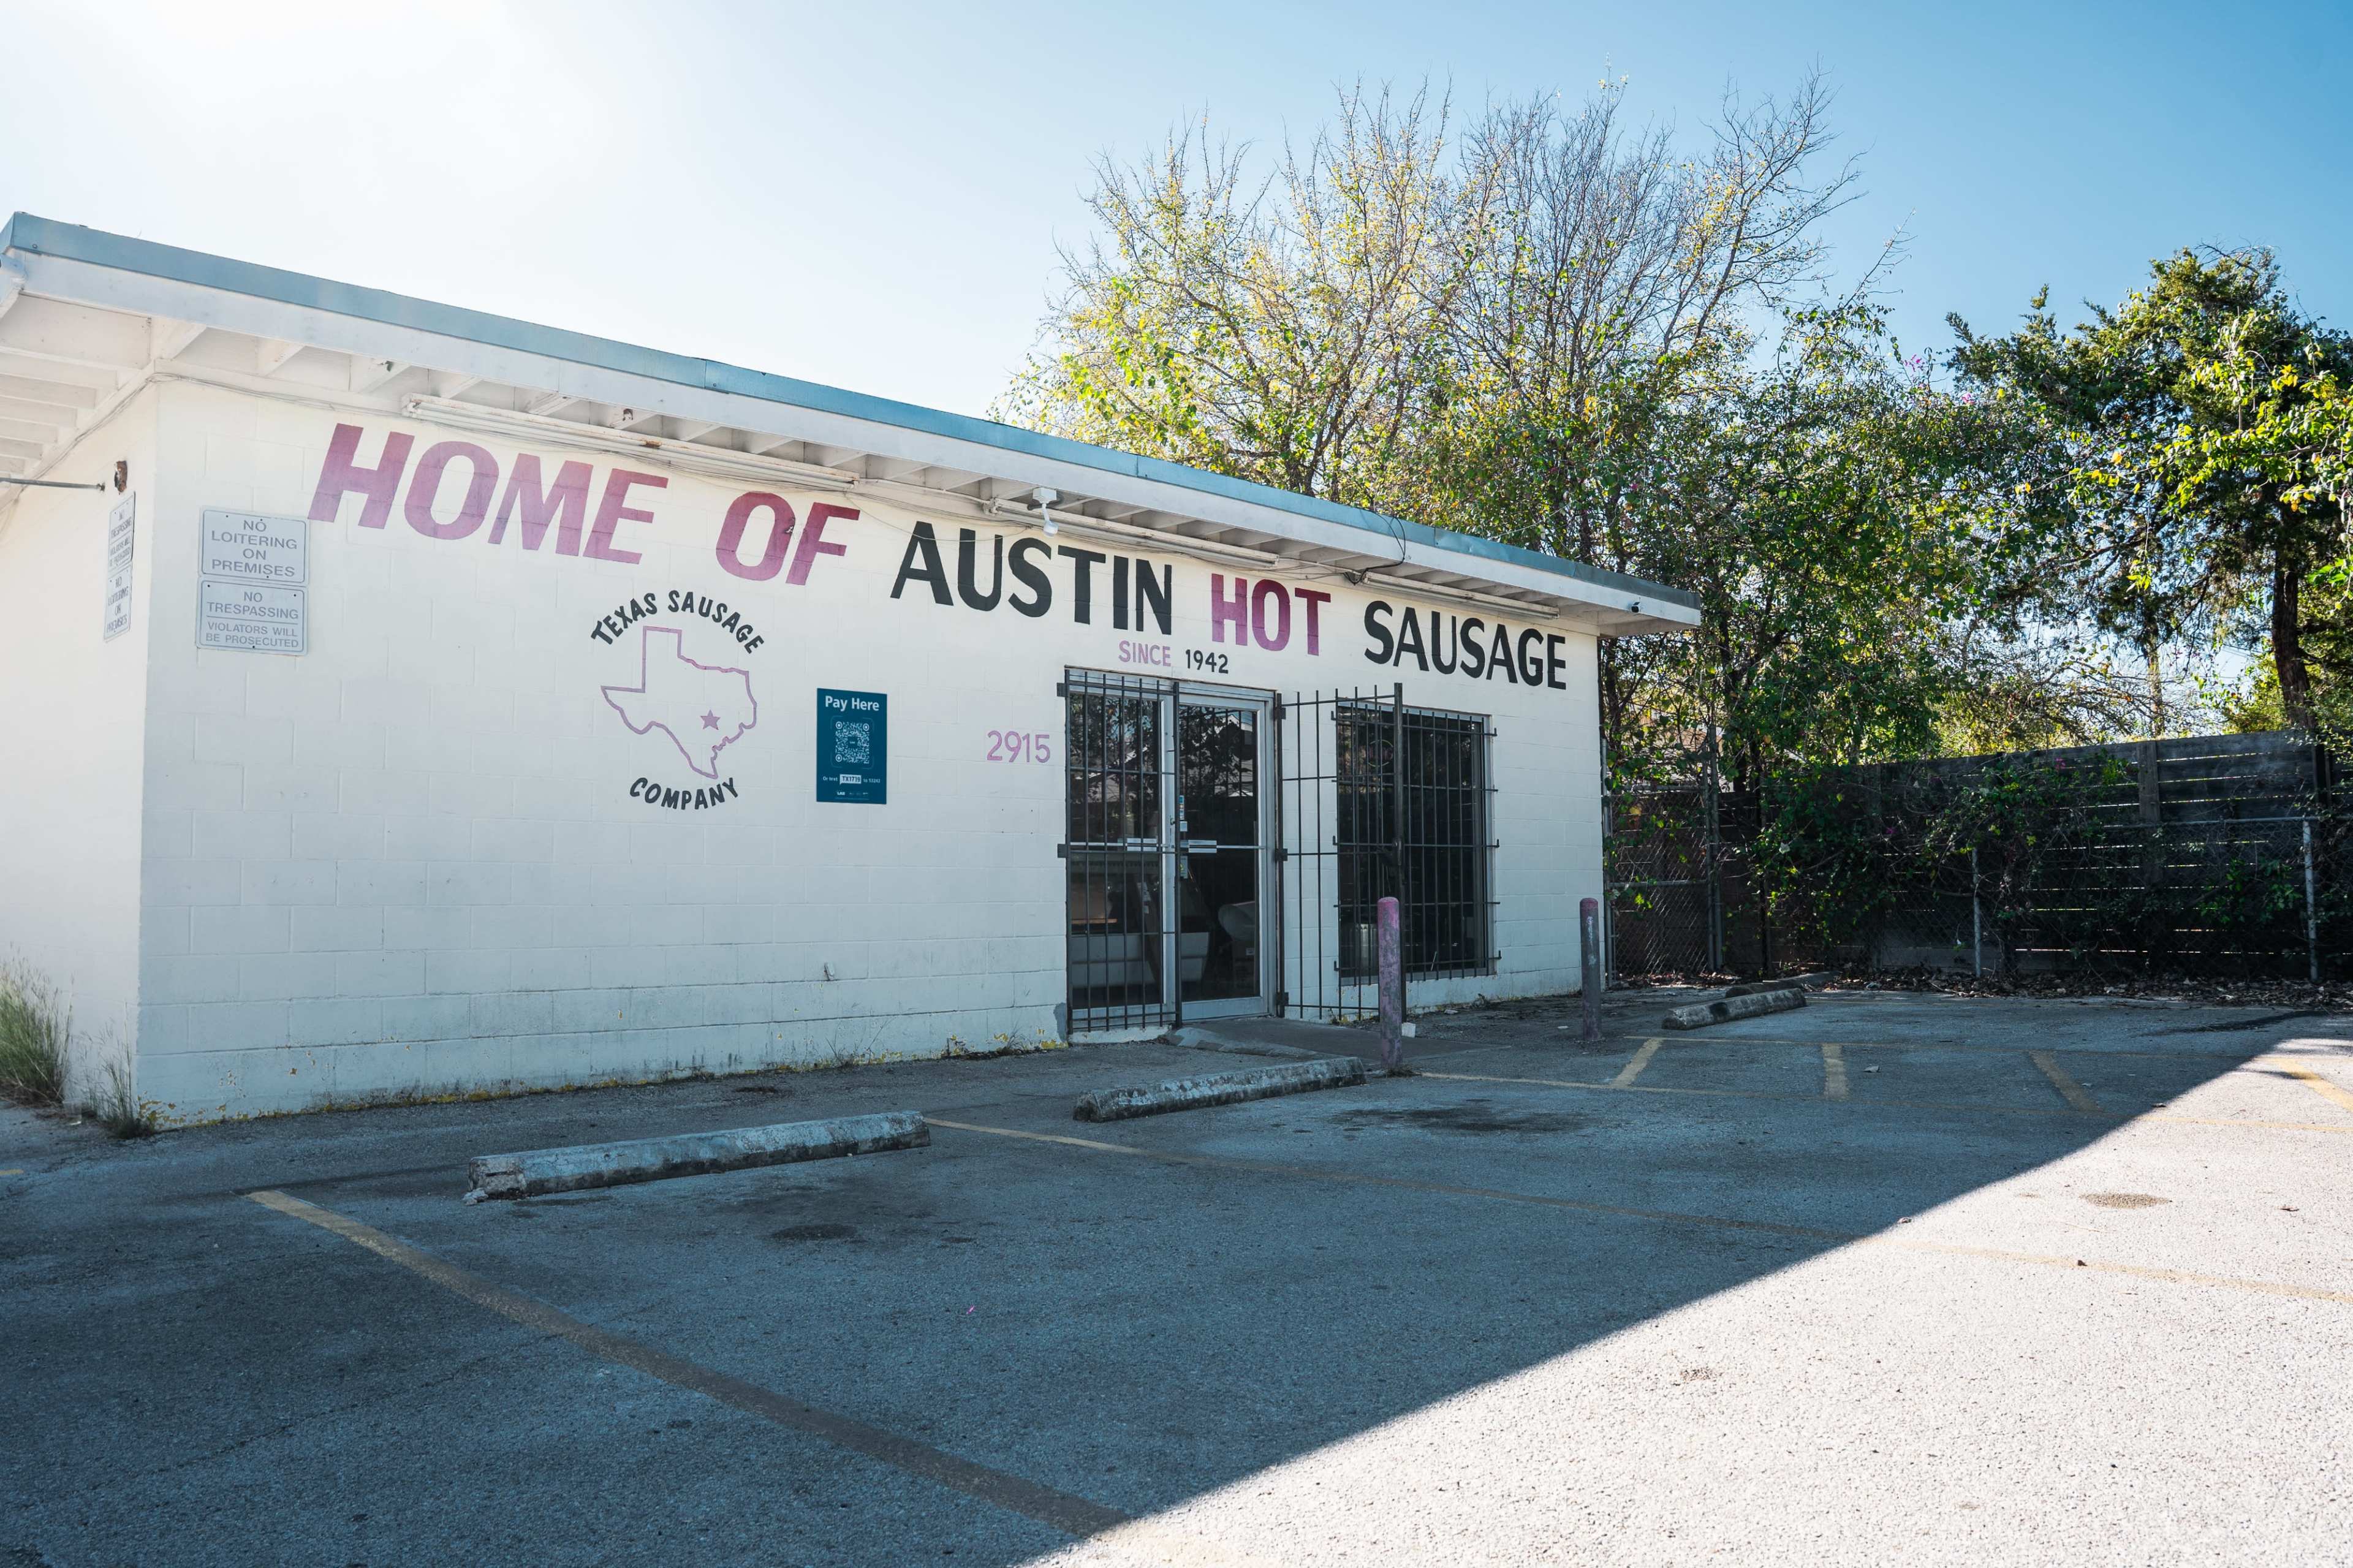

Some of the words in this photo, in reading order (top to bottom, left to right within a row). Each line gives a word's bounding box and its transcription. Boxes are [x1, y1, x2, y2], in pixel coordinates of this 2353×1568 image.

[243, 520, 267, 532] NO
[211, 530, 297, 549] LOITERING
[243, 548, 266, 560] ON
[308, 423, 668, 564] HOME
[716, 491, 860, 586] OF
[890, 521, 1172, 635] AUSTIN
[1211, 574, 1332, 656] HOT
[1365, 600, 1566, 690] SAUSAGE
[211, 559, 295, 577] PREMISES
[244, 591, 263, 602] NO
[207, 602, 298, 619] TRESPASSING
[208, 622, 268, 635] VIOLATORS
[273, 627, 298, 637] WILL
[591, 593, 657, 645] TEXAS
[668, 590, 765, 654] SAUSAGE
[206, 632, 221, 642] BE
[225, 634, 298, 648] PROSECUTED
[1118, 640, 1171, 667] SINCE
[1185, 649, 1229, 674] 1942
[825, 695, 847, 711] Pay
[851, 697, 879, 711] Here
[987, 730, 1050, 763] 2915
[629, 777, 738, 810] COMPANY
